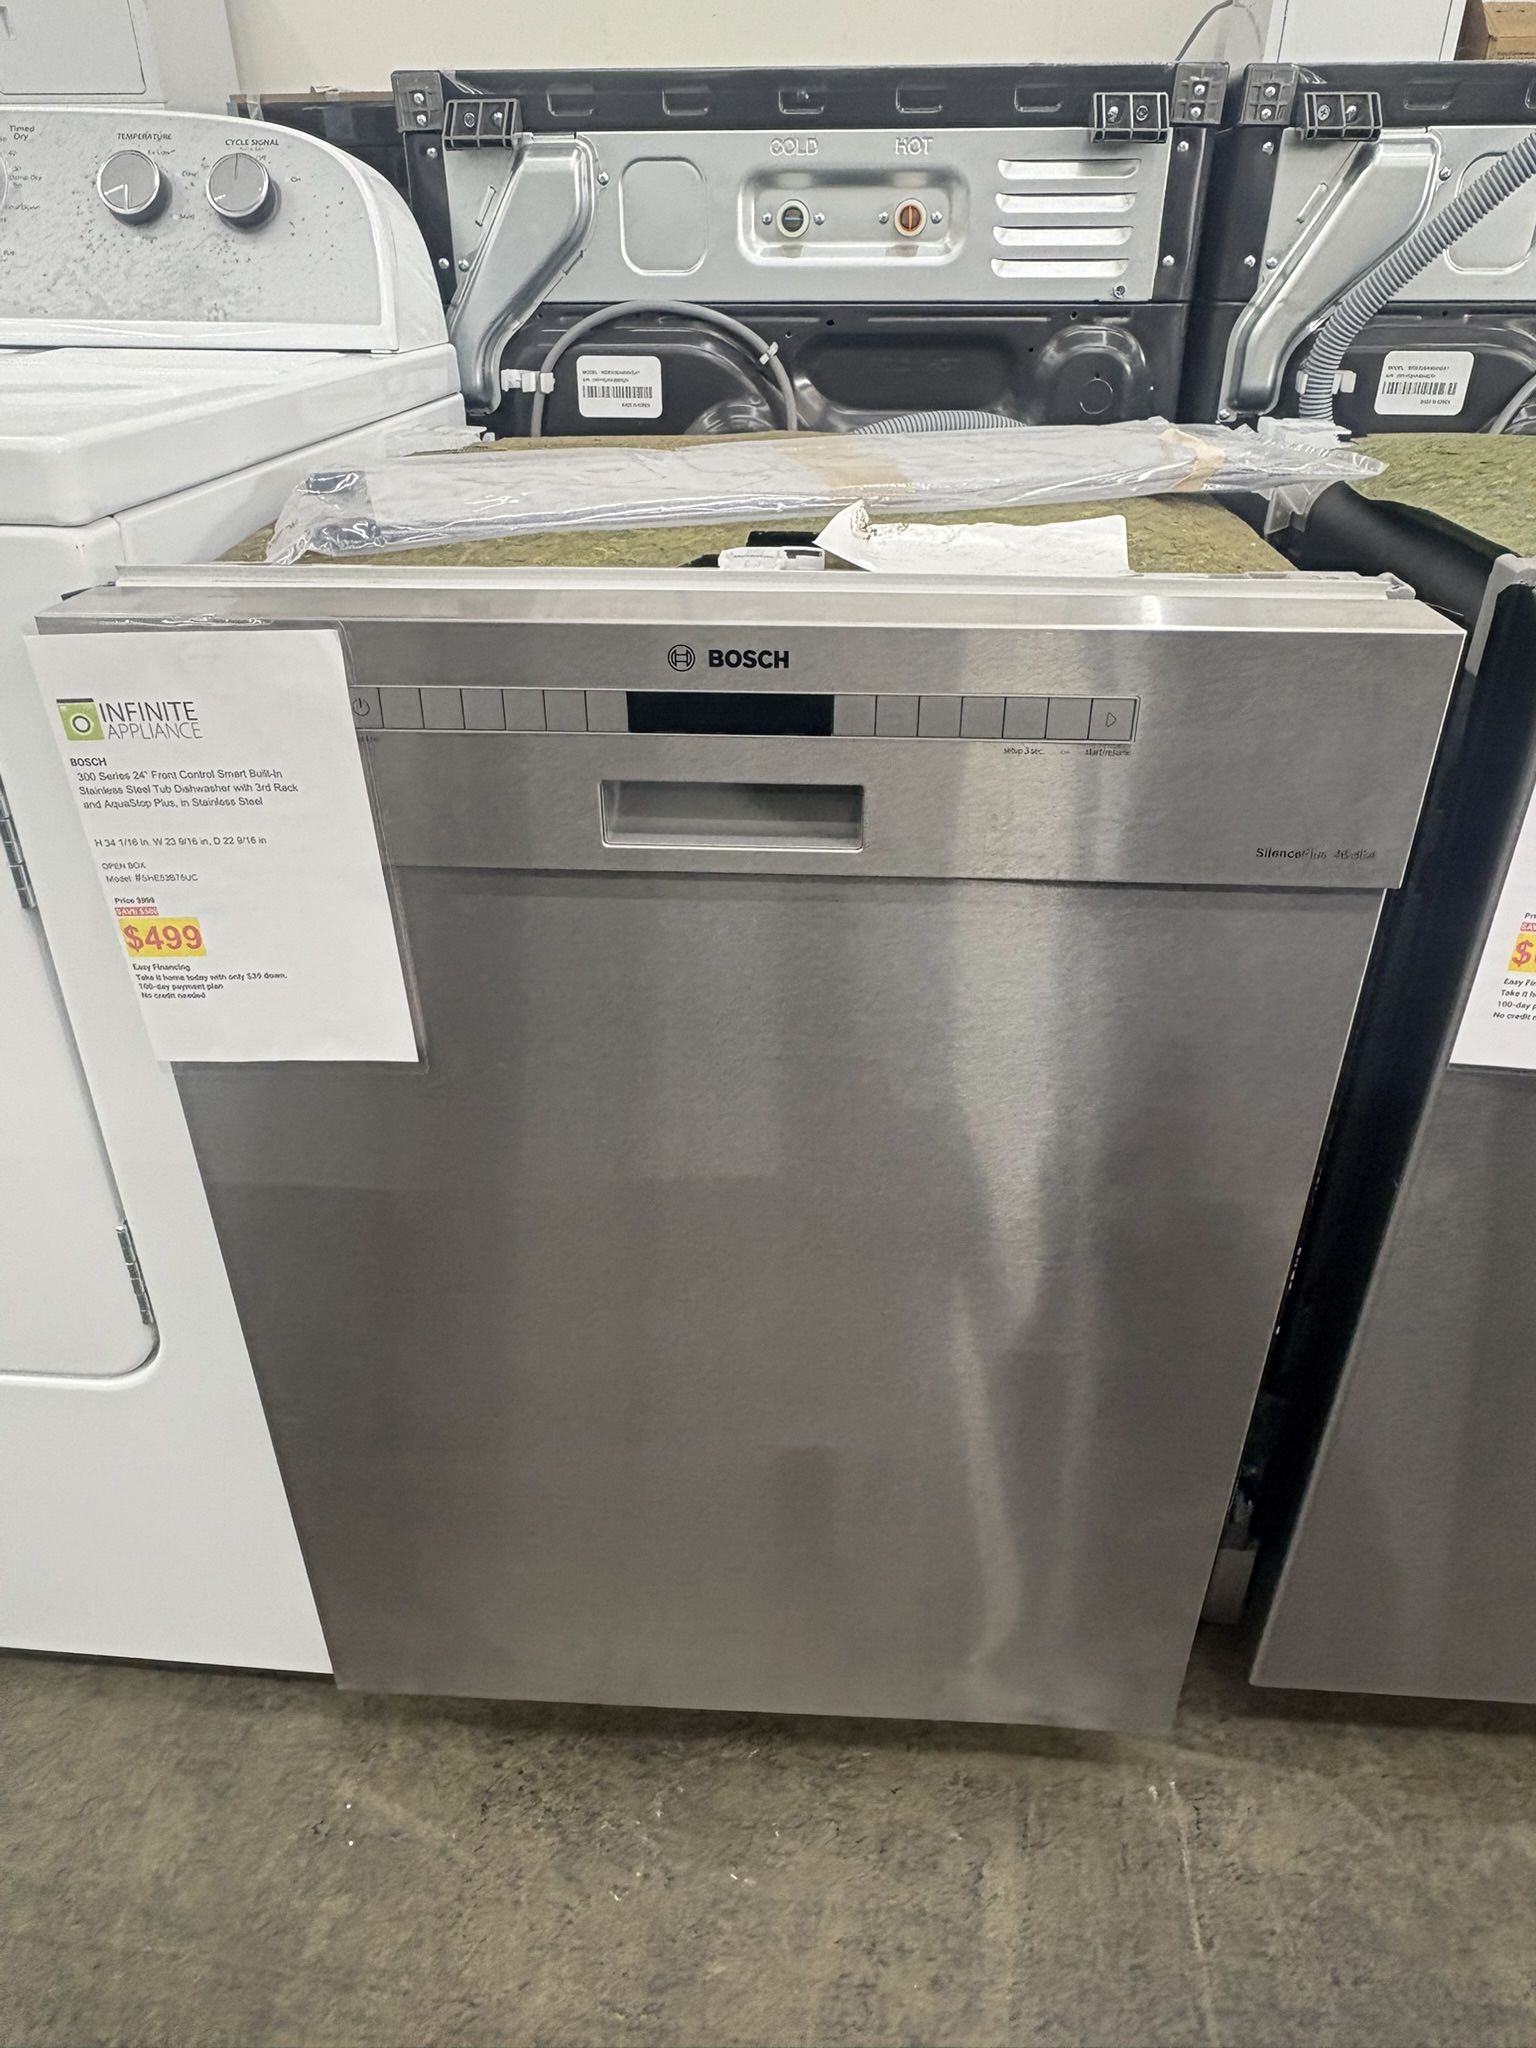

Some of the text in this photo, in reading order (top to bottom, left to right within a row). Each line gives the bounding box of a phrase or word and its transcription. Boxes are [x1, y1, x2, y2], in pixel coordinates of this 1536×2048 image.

[9, 124, 35, 132] Timed
[13, 132, 29, 141] Dry
[117, 132, 172, 140] TEMPERATURE
[224, 138, 280, 146] CYCLE SIGNAL
[769, 137, 820, 156] COLD
[895, 135, 935, 156] HOT
[708, 649, 790, 669] BOSCH
[98, 701, 198, 722] INFINITE
[108, 721, 203, 740] APPLIANCE
[70, 757, 107, 767] BOSCH
[77, 772, 97, 781] 300
[98, 771, 131, 781] Series
[151, 770, 178, 780] Front
[179, 769, 216, 779] Control
[217, 768, 248, 779] Smart
[249, 768, 283, 779] Built-In
[79, 783, 299, 796] Stainless Steel Tub Dishwasher with 3rd Rack
[83, 799, 102, 809] and
[104, 798, 152, 810] AquaStop
[180, 799, 191, 808] in
[192, 797, 237, 808] Stainless
[238, 796, 264, 807] Steel
[94, 838, 103, 847] H
[105, 838, 117, 847] 34
[153, 837, 163, 846] W
[165, 837, 177, 846] 23
[213, 837, 221, 845] D
[223, 836, 235, 845] 22
[258, 836, 268, 845] in
[102, 862, 126, 870] OPEN
[106, 875, 132, 883] Model
[123, 924, 203, 952] $499
[1504, 977, 1523, 987] Easy
[1501, 989, 1520, 997] Take
[1498, 1000, 1531, 1010] 100-day
